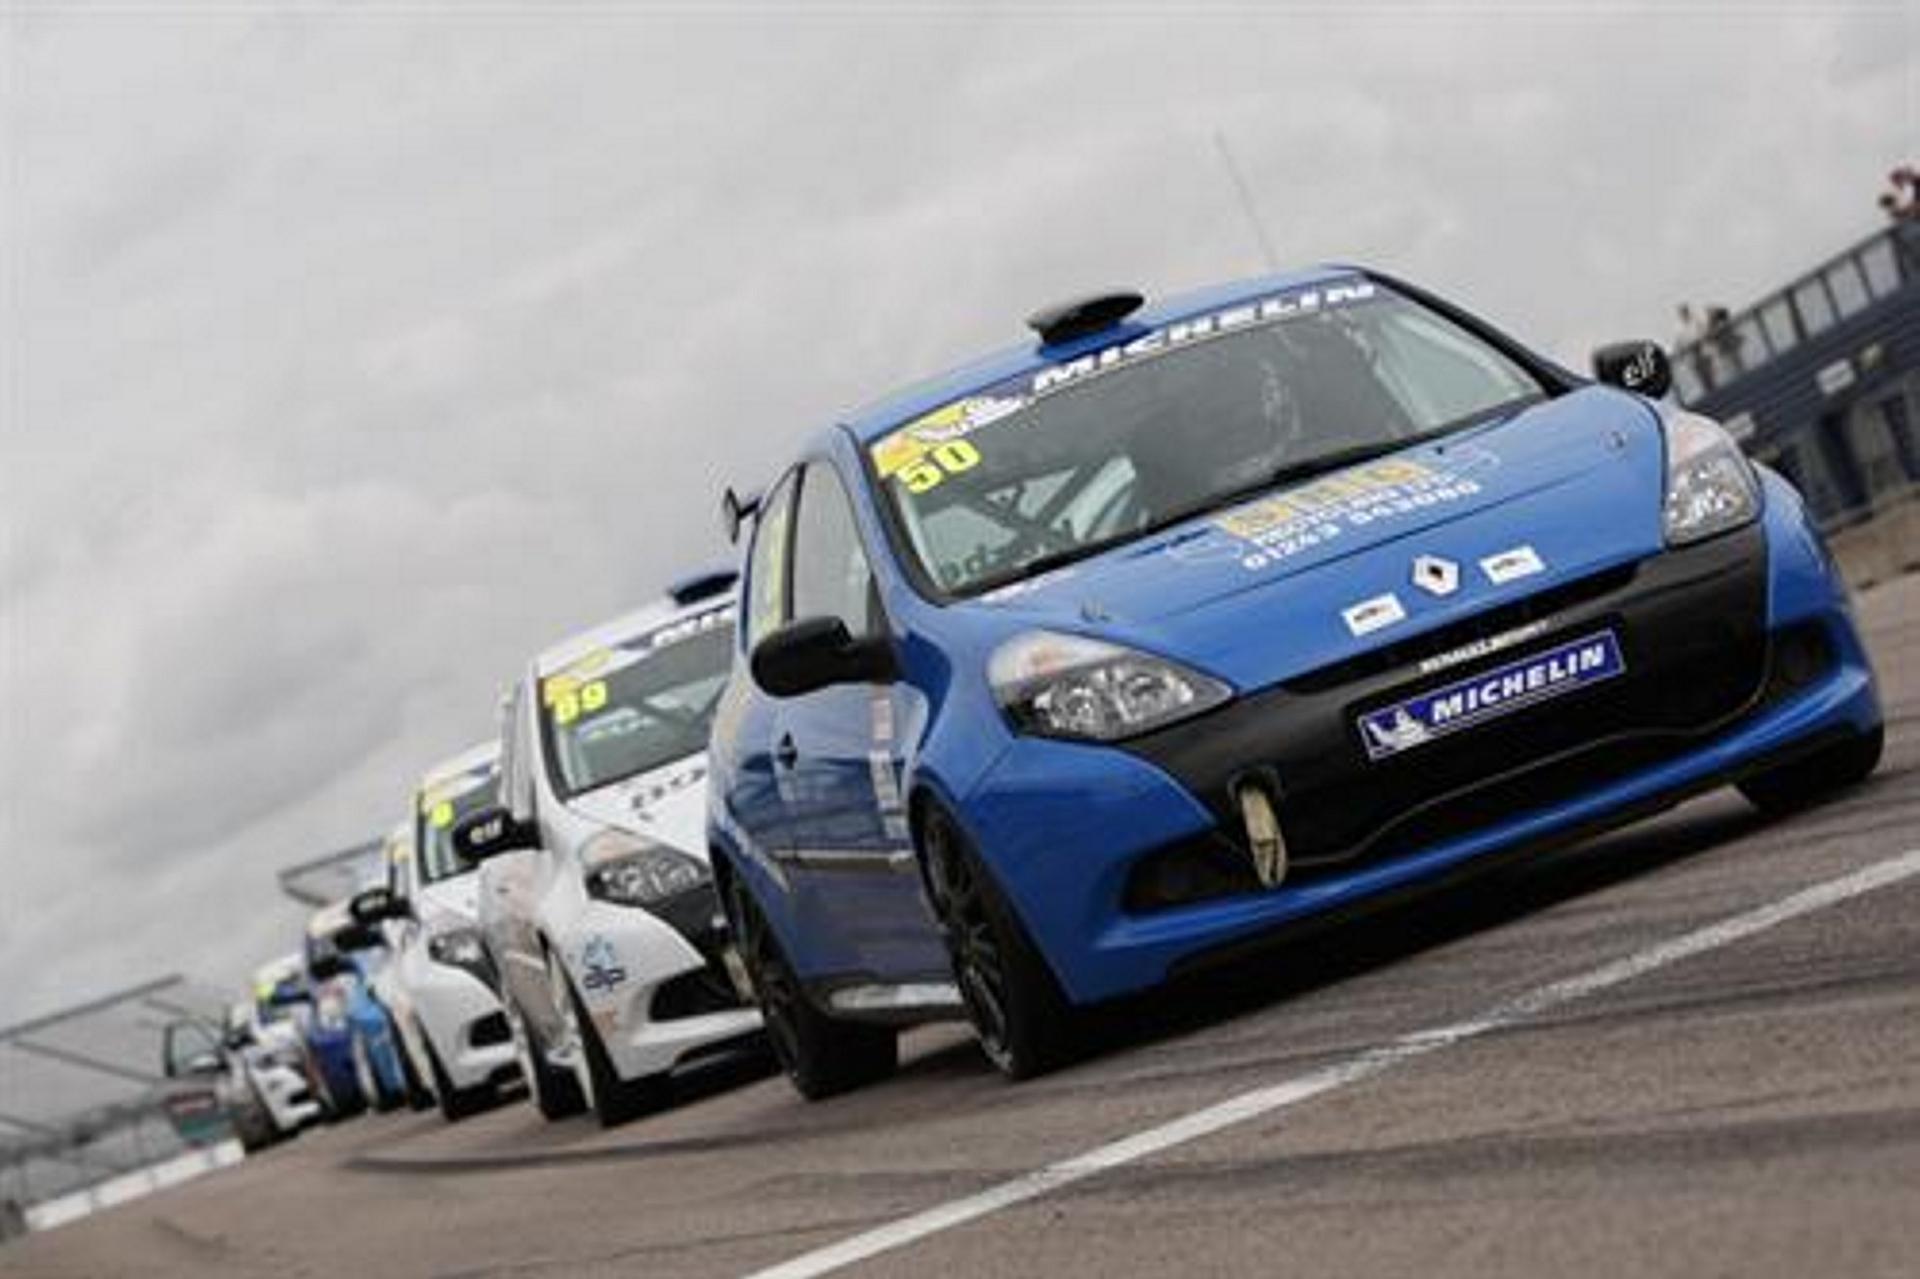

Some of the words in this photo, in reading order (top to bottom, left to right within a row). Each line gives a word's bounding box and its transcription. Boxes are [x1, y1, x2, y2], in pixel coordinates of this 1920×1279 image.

[1033, 283, 1375, 391] MICHELIN
[897, 438, 981, 494] 50
[1431, 643, 1607, 725] MICHELIN
